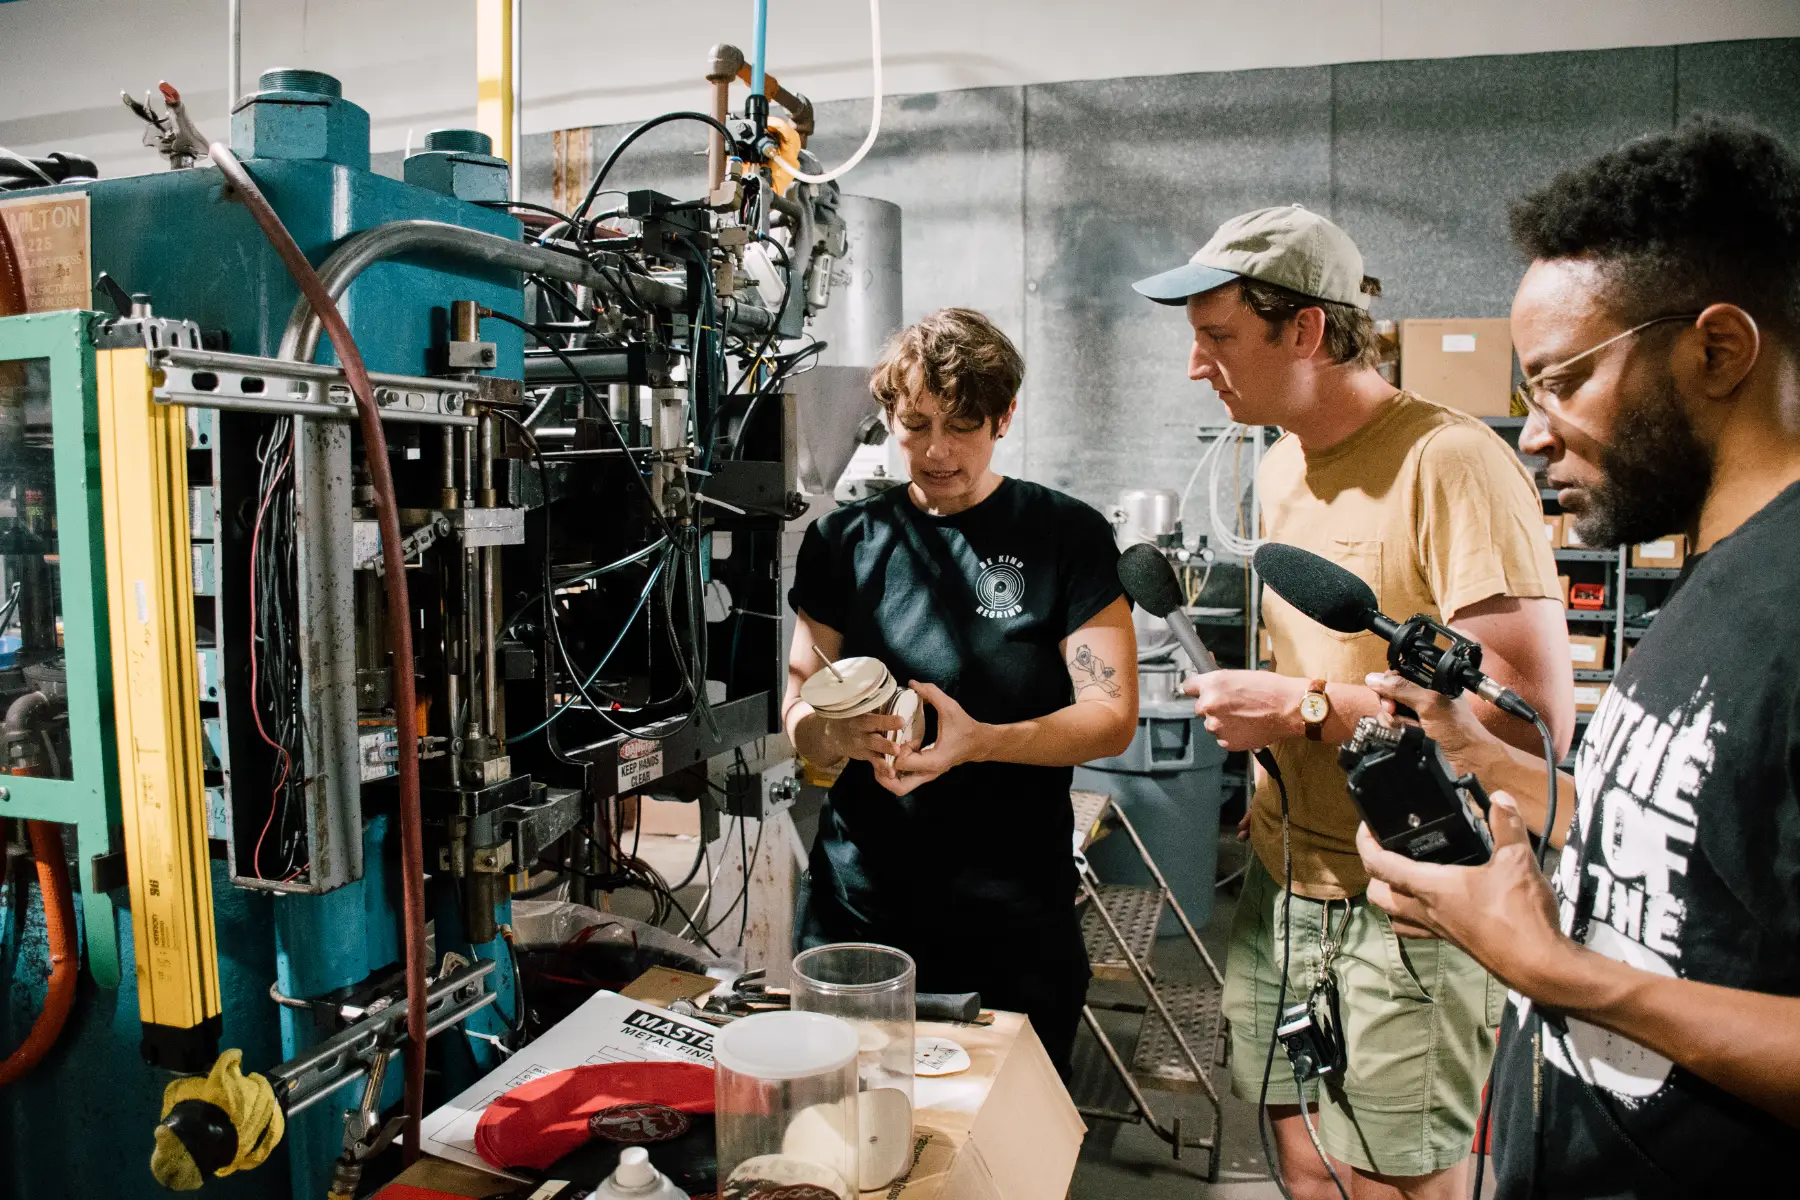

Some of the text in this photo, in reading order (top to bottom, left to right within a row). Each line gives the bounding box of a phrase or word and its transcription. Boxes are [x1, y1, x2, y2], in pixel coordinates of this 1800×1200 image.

[3, 206, 80, 234] MILTON
[979, 555, 1024, 569] BE KIND
[976, 605, 1023, 618] REGRIND
[621, 754, 659, 777] KEEP HANDS
[630, 771, 651, 787] CLEAR
[1601, 786, 1698, 900] OF
[1587, 862, 1688, 959] THE
[620, 1026, 672, 1048] METAL
